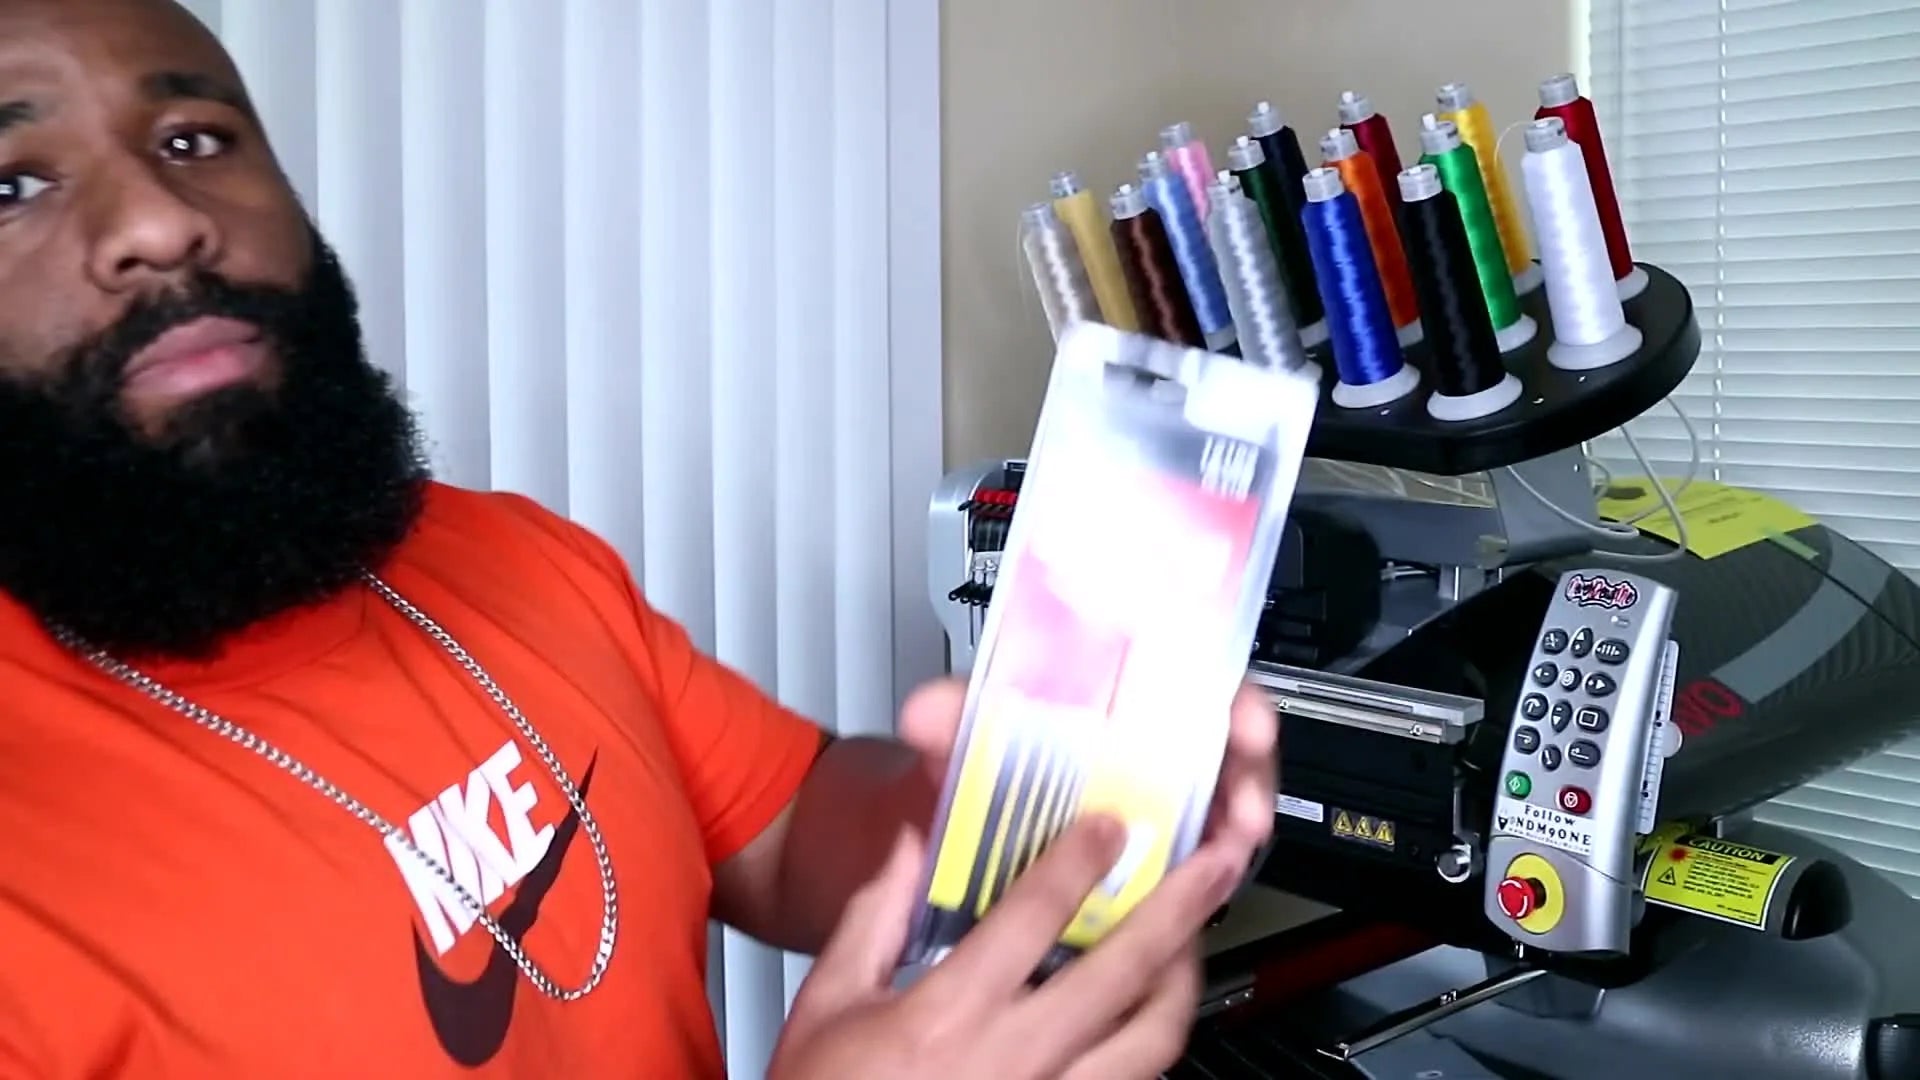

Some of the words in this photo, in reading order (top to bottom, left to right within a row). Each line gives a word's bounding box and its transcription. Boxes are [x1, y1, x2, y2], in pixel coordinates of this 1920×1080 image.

[1524, 804, 1576, 826] Follow
[383, 739, 556, 957] NIKE
[1688, 838, 1766, 862] CAUTION
